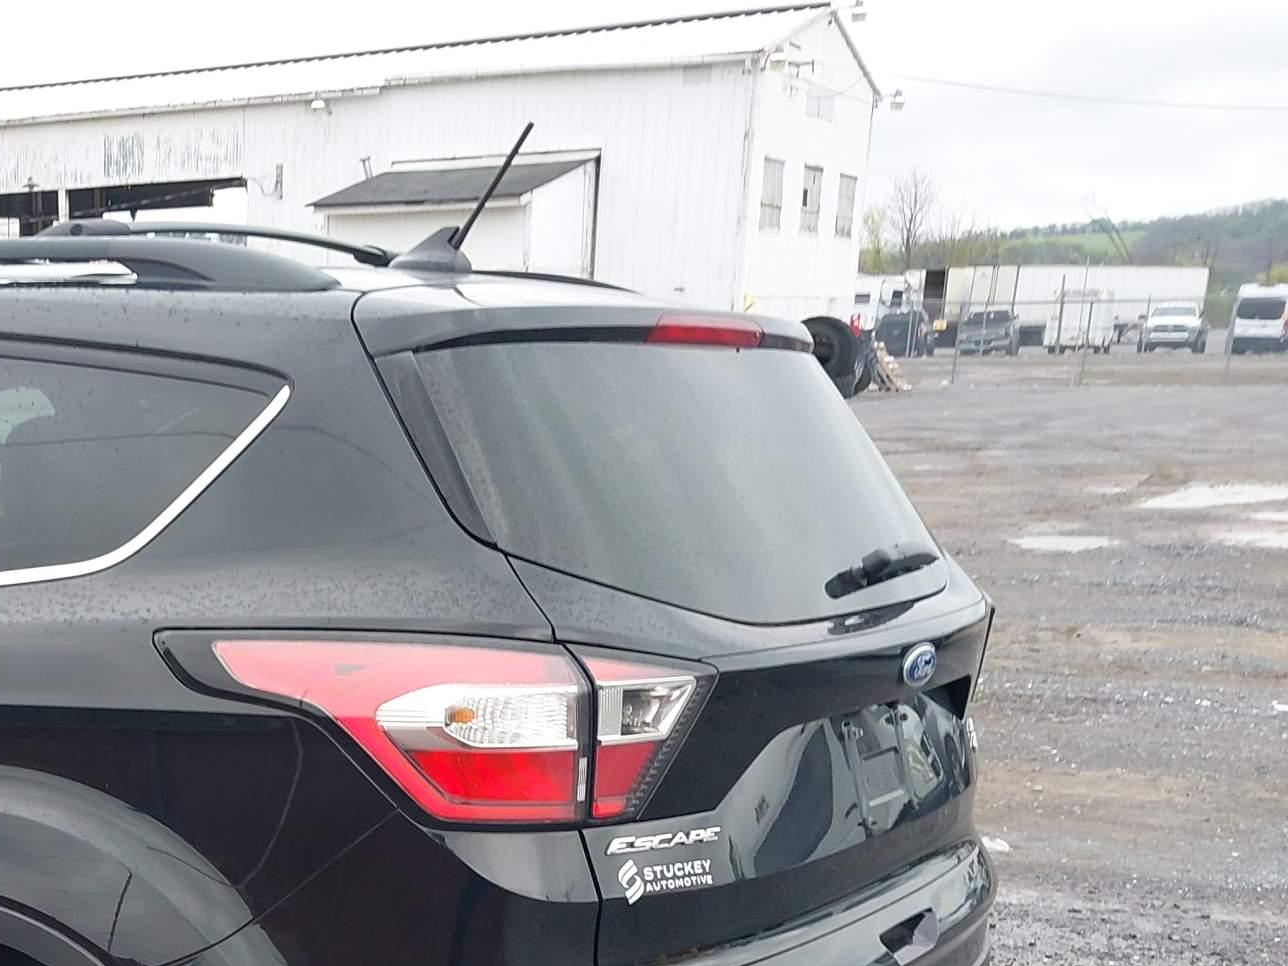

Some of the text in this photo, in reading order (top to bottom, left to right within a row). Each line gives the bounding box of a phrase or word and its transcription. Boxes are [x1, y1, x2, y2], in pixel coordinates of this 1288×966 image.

[605, 826, 721, 856] ESCAPE
[642, 858, 712, 881] STUCKEY
[645, 874, 714, 893] AUTOMOTIVE
